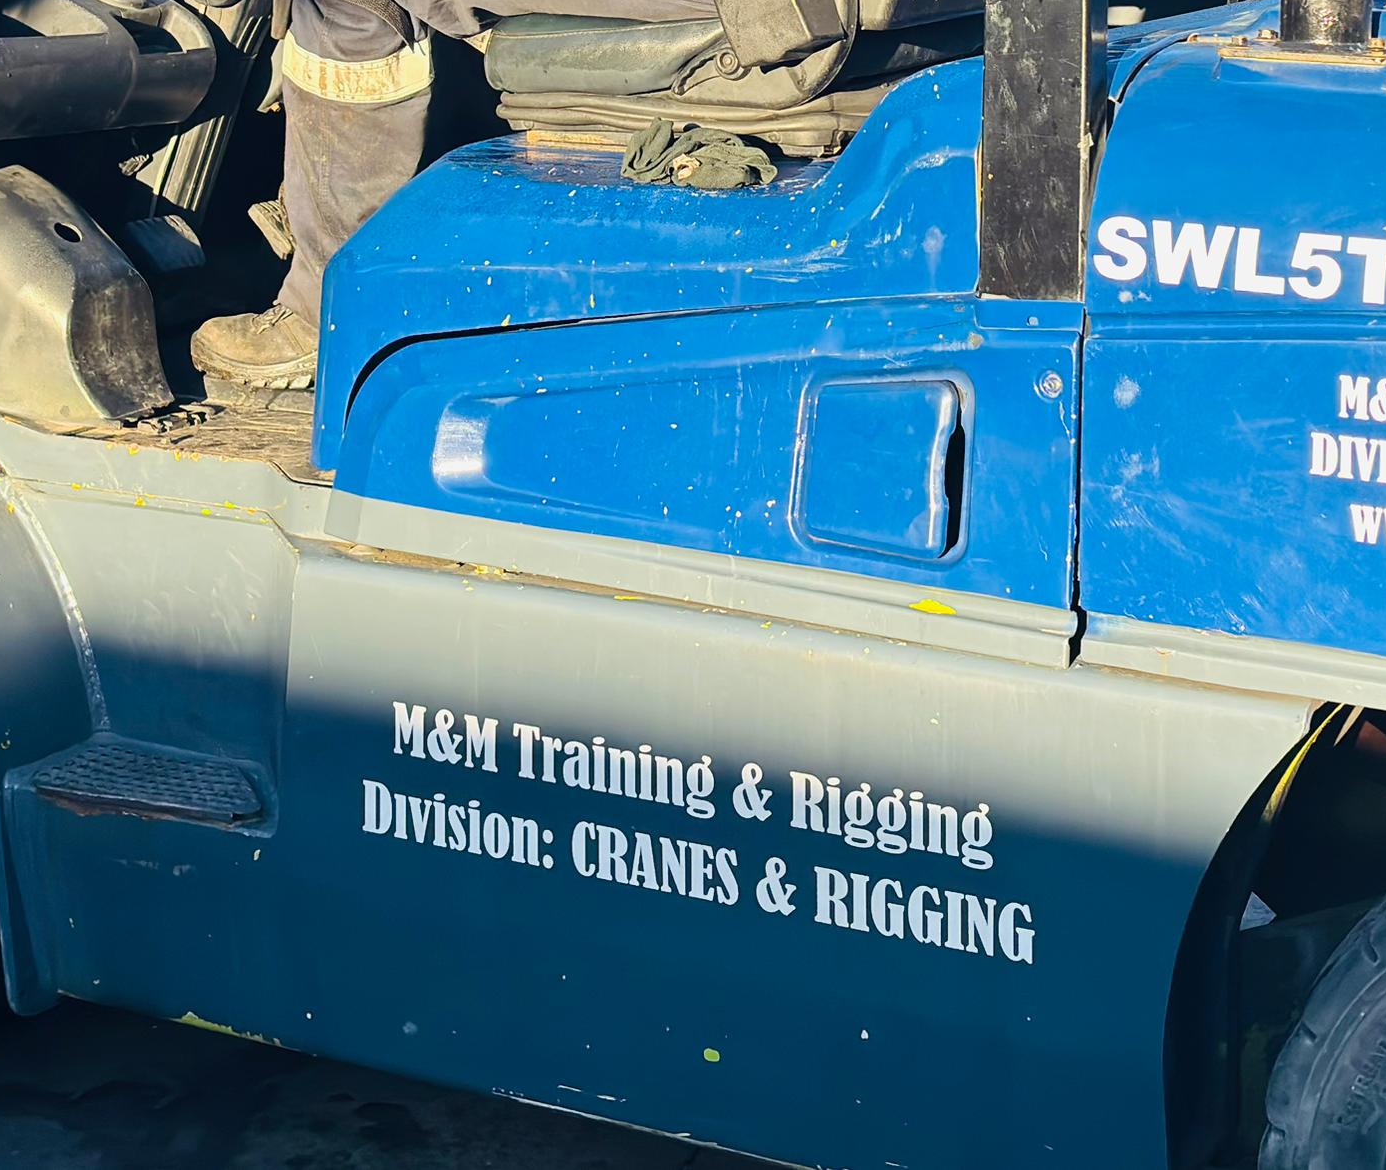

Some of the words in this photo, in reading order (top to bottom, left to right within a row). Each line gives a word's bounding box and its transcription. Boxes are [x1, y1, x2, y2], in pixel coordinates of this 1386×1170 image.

[362, 779, 555, 870] Division:
[572, 821, 739, 906] CRANES
[756, 857, 797, 916] &
[814, 866, 1035, 965] RIGGING
[392, 701, 499, 773] M&M
[512, 722, 715, 819] Training
[732, 762, 773, 822] &
[789, 771, 995, 871] Rigging
